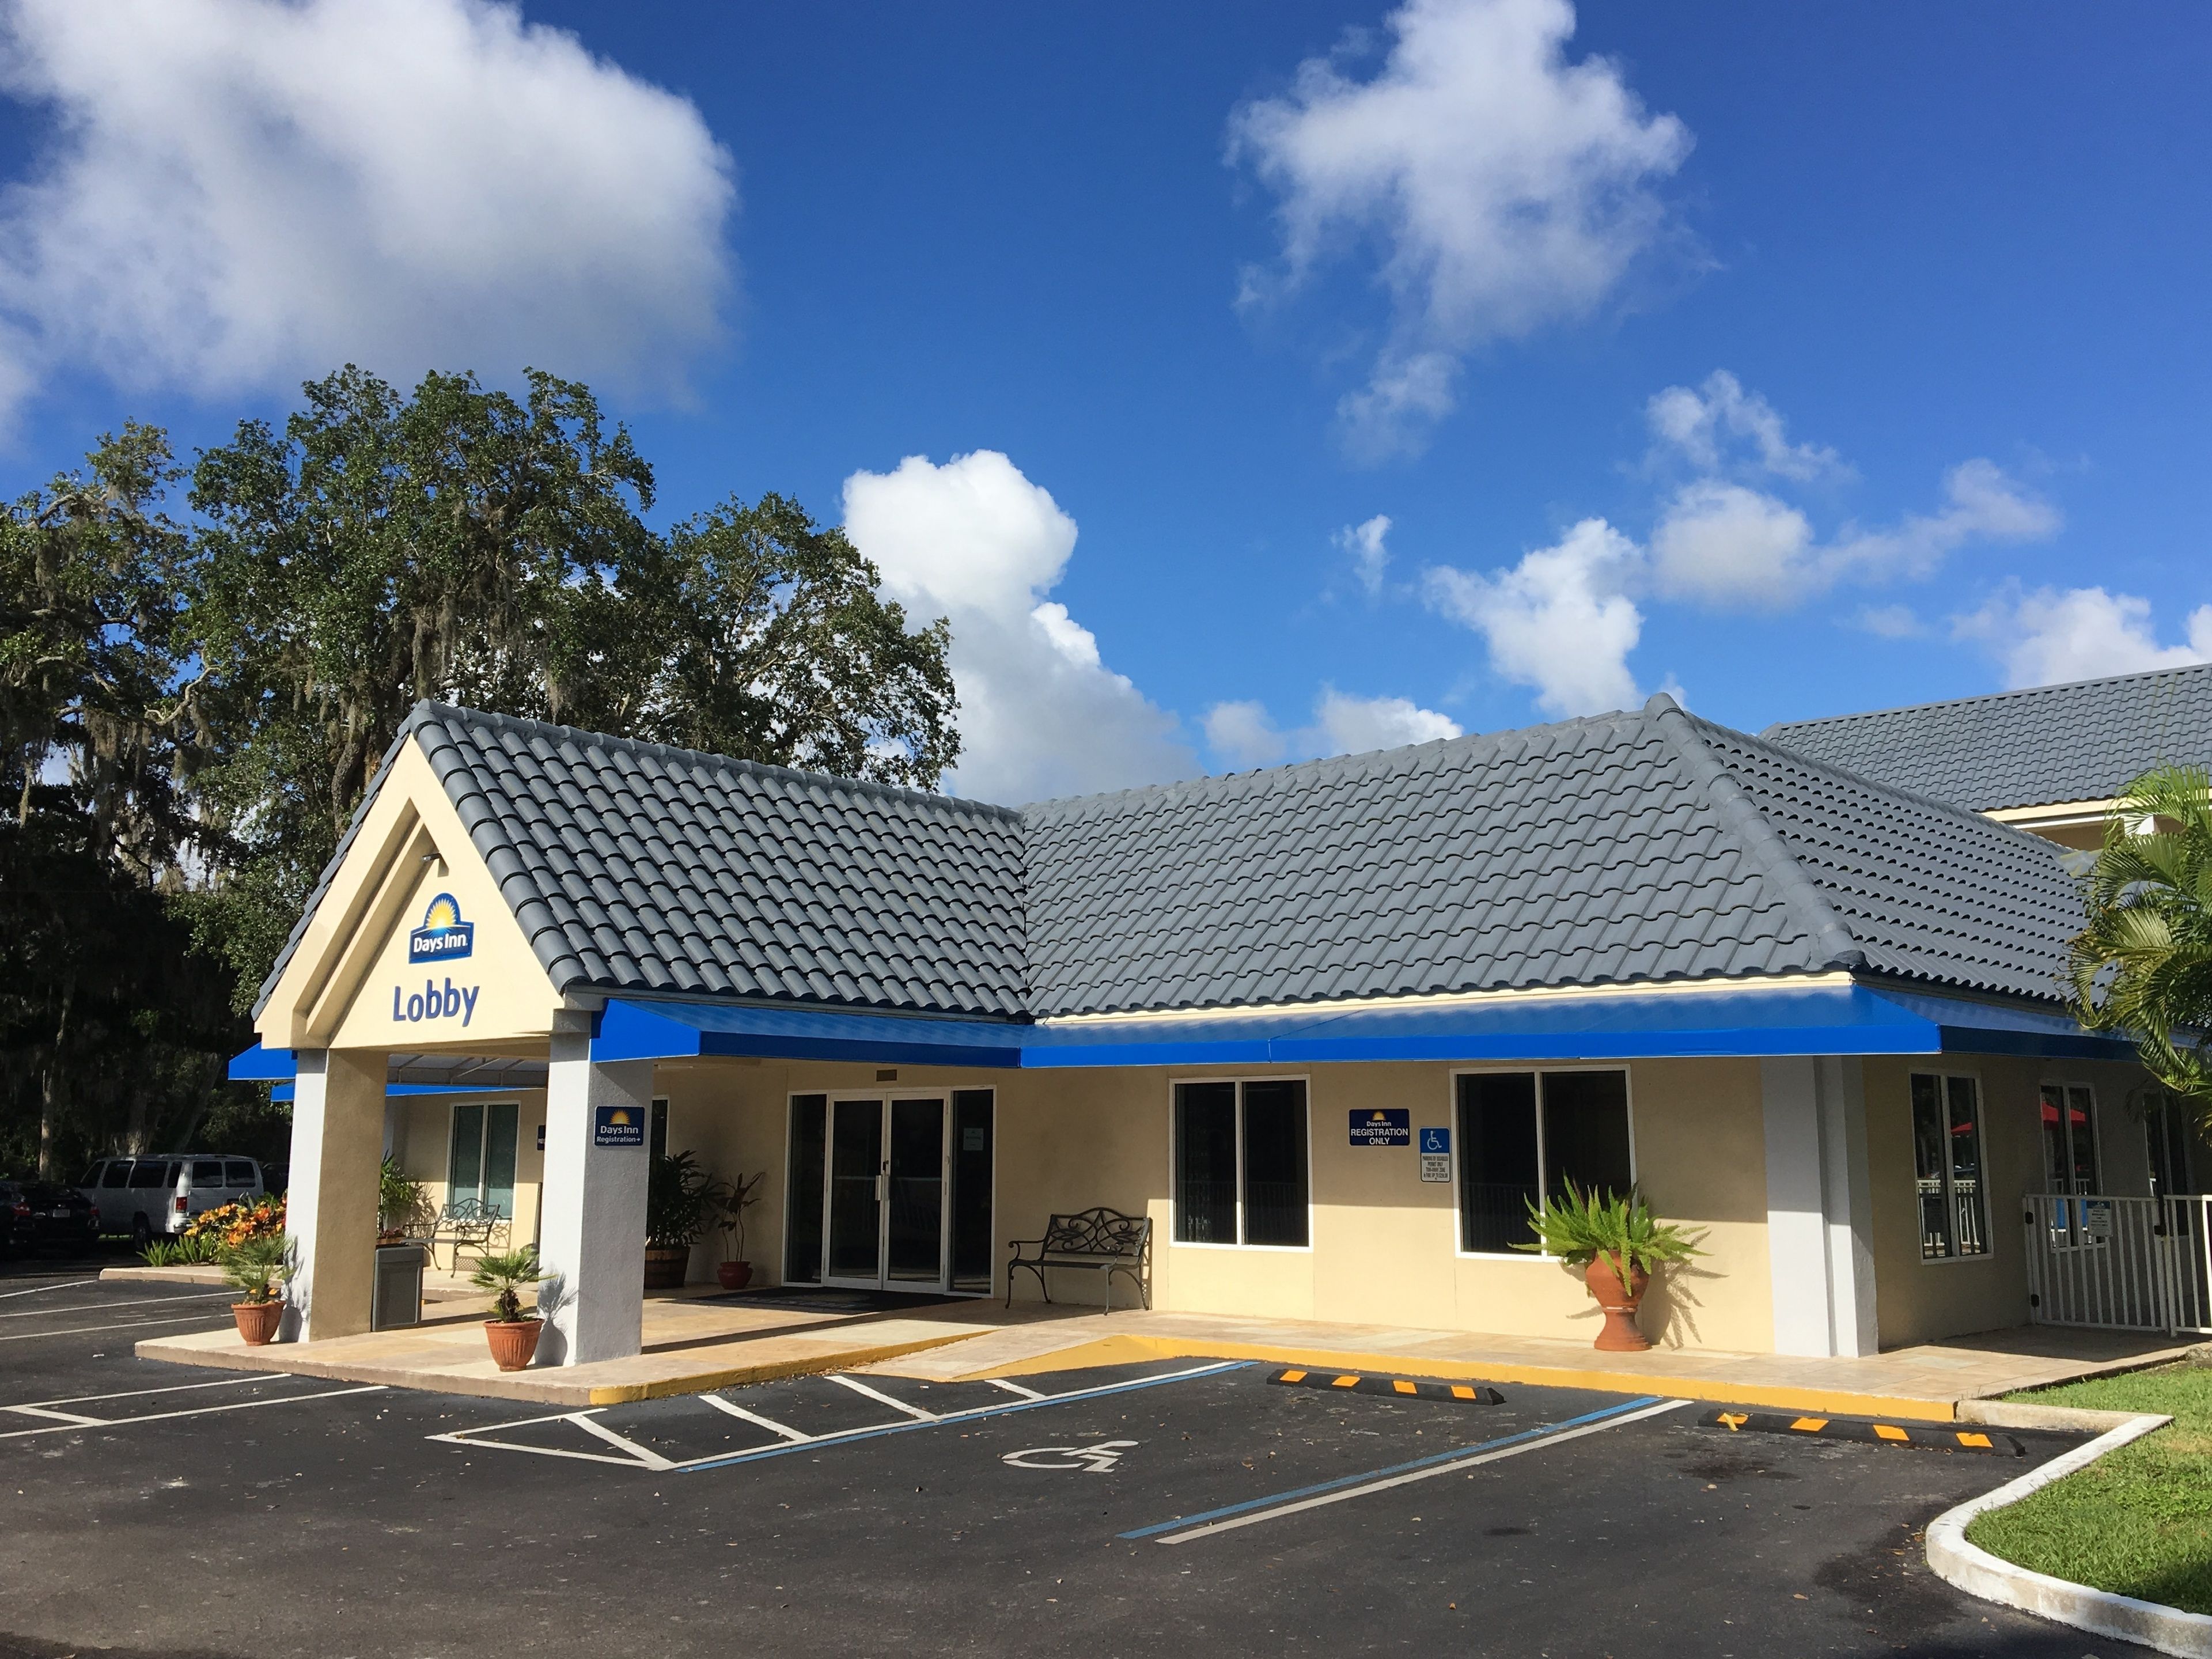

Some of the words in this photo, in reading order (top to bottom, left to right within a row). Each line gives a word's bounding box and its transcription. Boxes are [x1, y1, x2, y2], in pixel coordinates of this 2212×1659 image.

[414, 937, 443, 953] Days
[445, 933, 466, 949] Inn
[393, 977, 480, 1027] Lobby
[600, 1125, 622, 1135] Days
[624, 1126, 638, 1134] Inn
[1351, 1128, 1408, 1136] REGISTRATION
